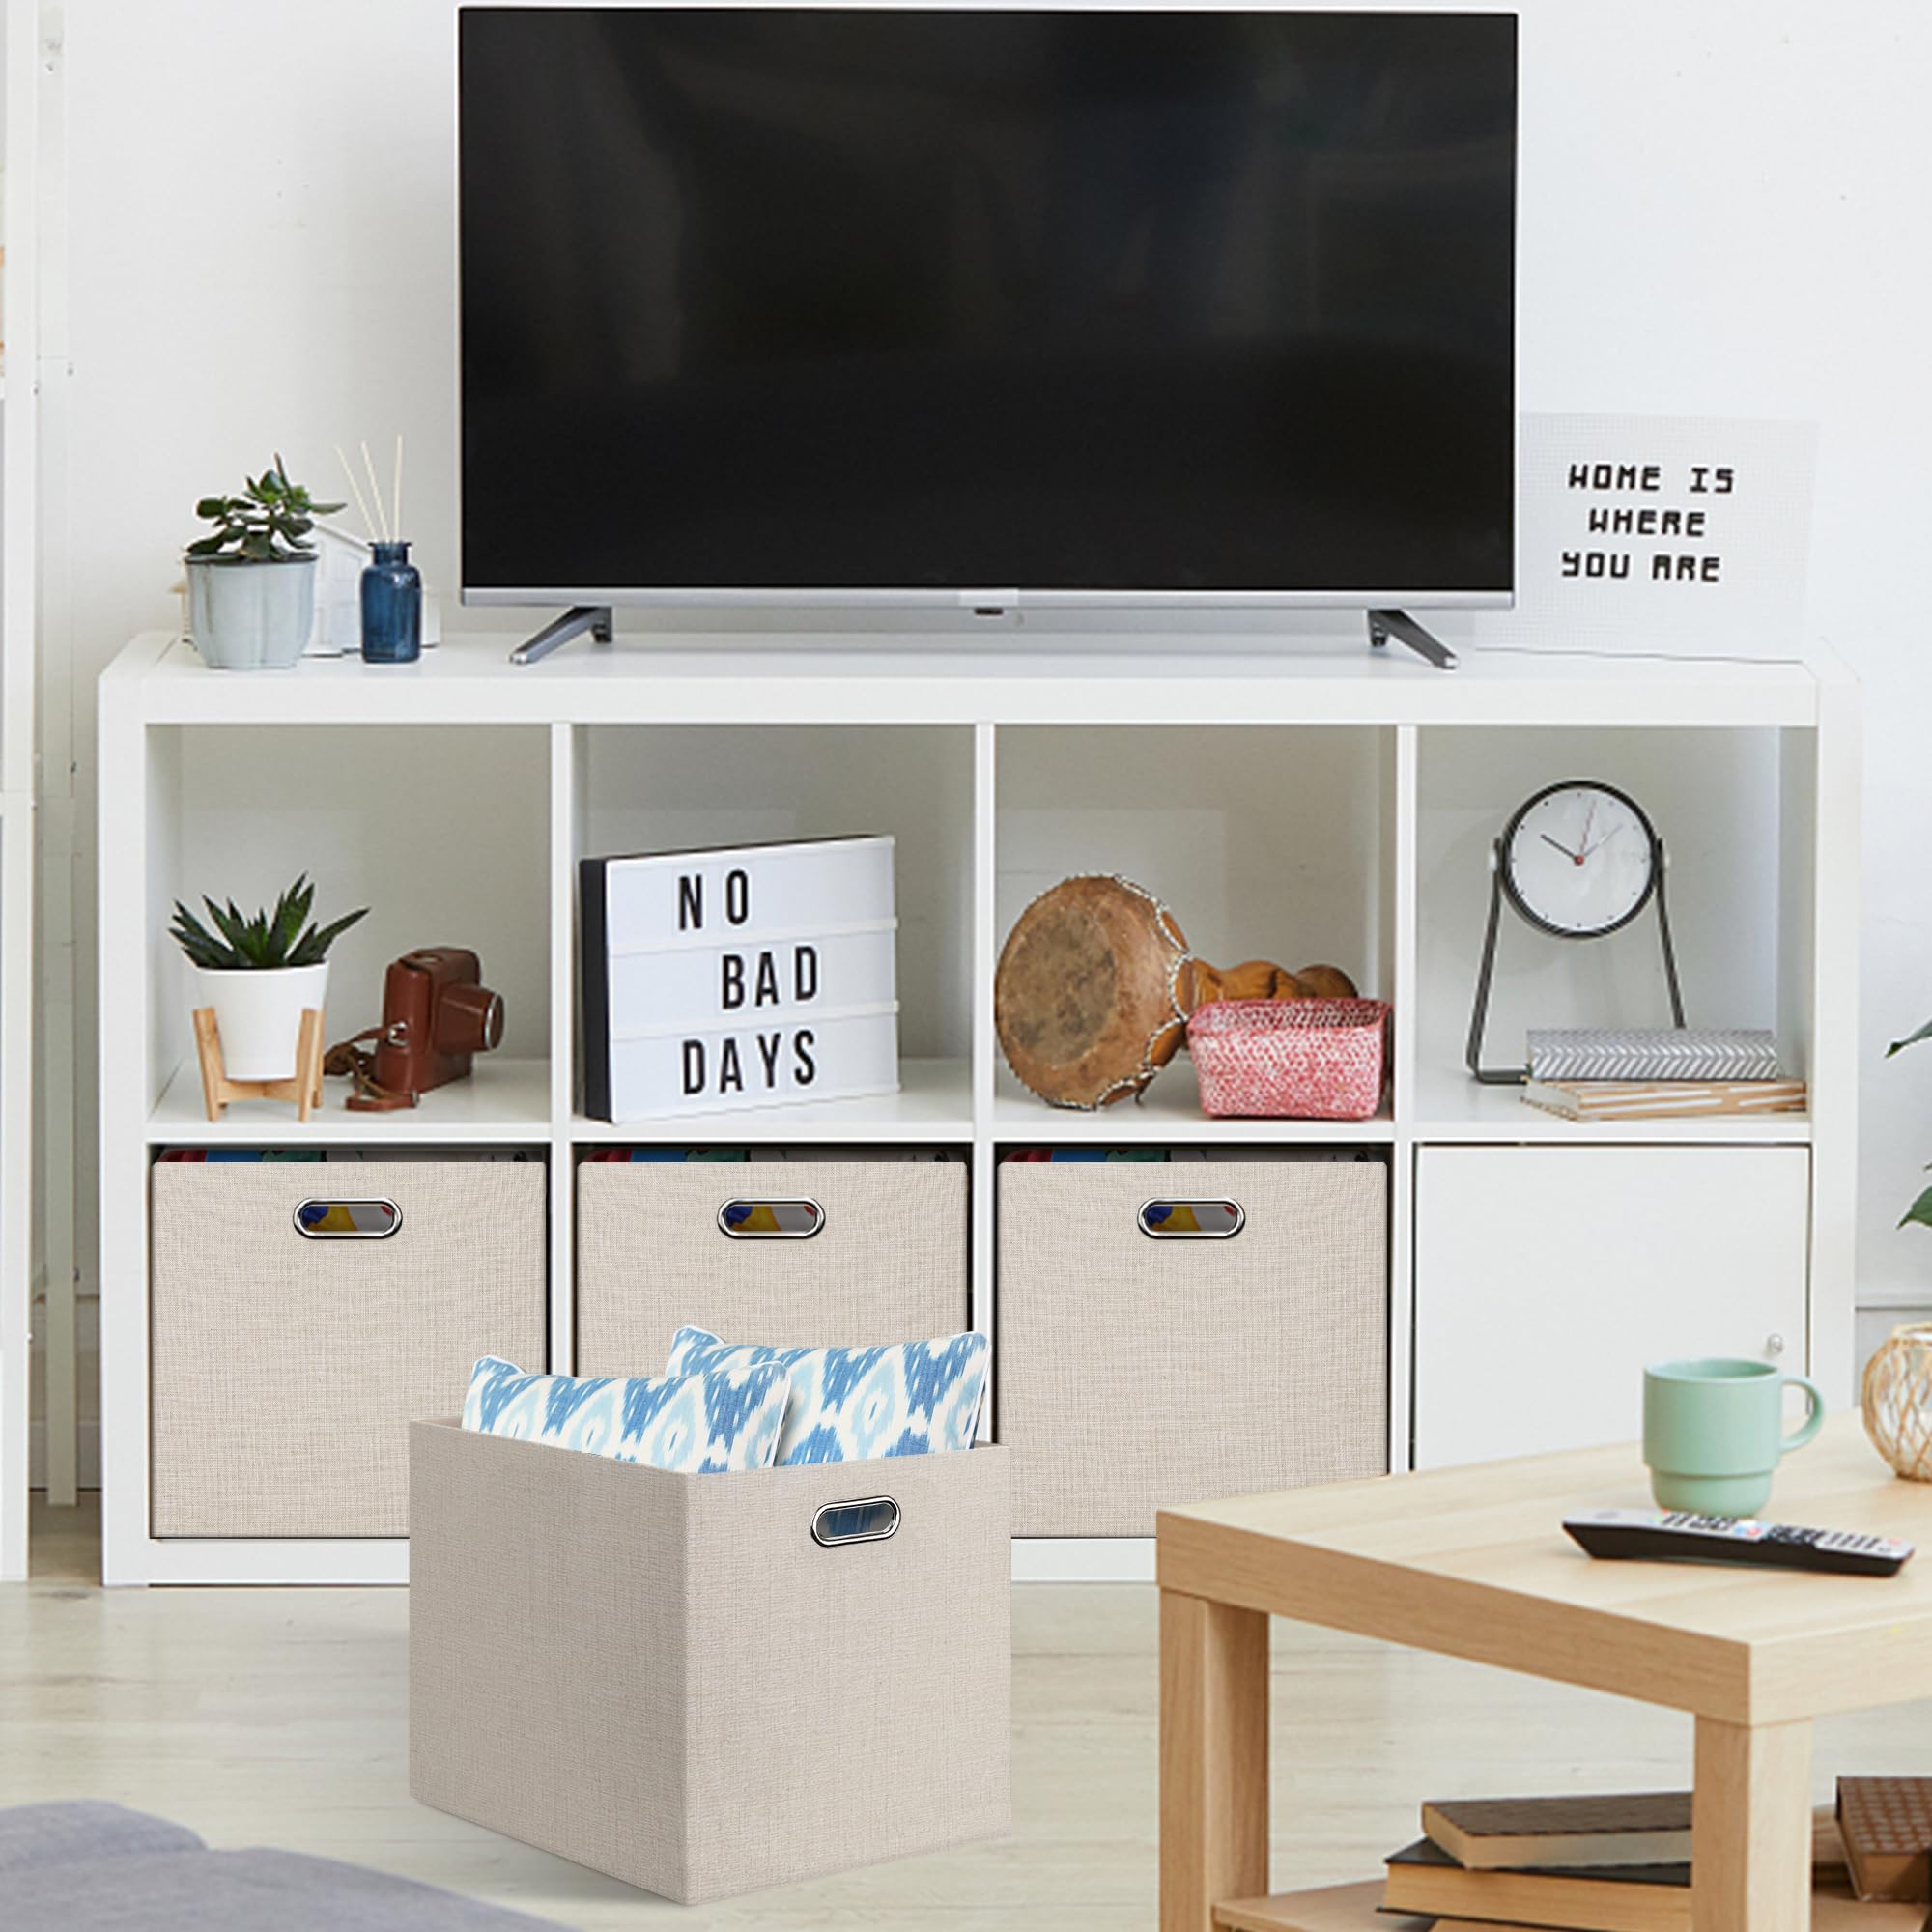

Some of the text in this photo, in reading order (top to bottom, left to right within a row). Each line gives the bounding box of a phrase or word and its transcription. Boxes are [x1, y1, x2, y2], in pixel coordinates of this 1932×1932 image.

[1568, 464, 1734, 494] HOME IS
[1589, 508, 1705, 537] WHERE
[1562, 552, 1720, 582] YOU ARE
[679, 869, 749, 931] NO
[722, 945, 817, 1010] BAD
[682, 1029, 815, 1095] DAYS
